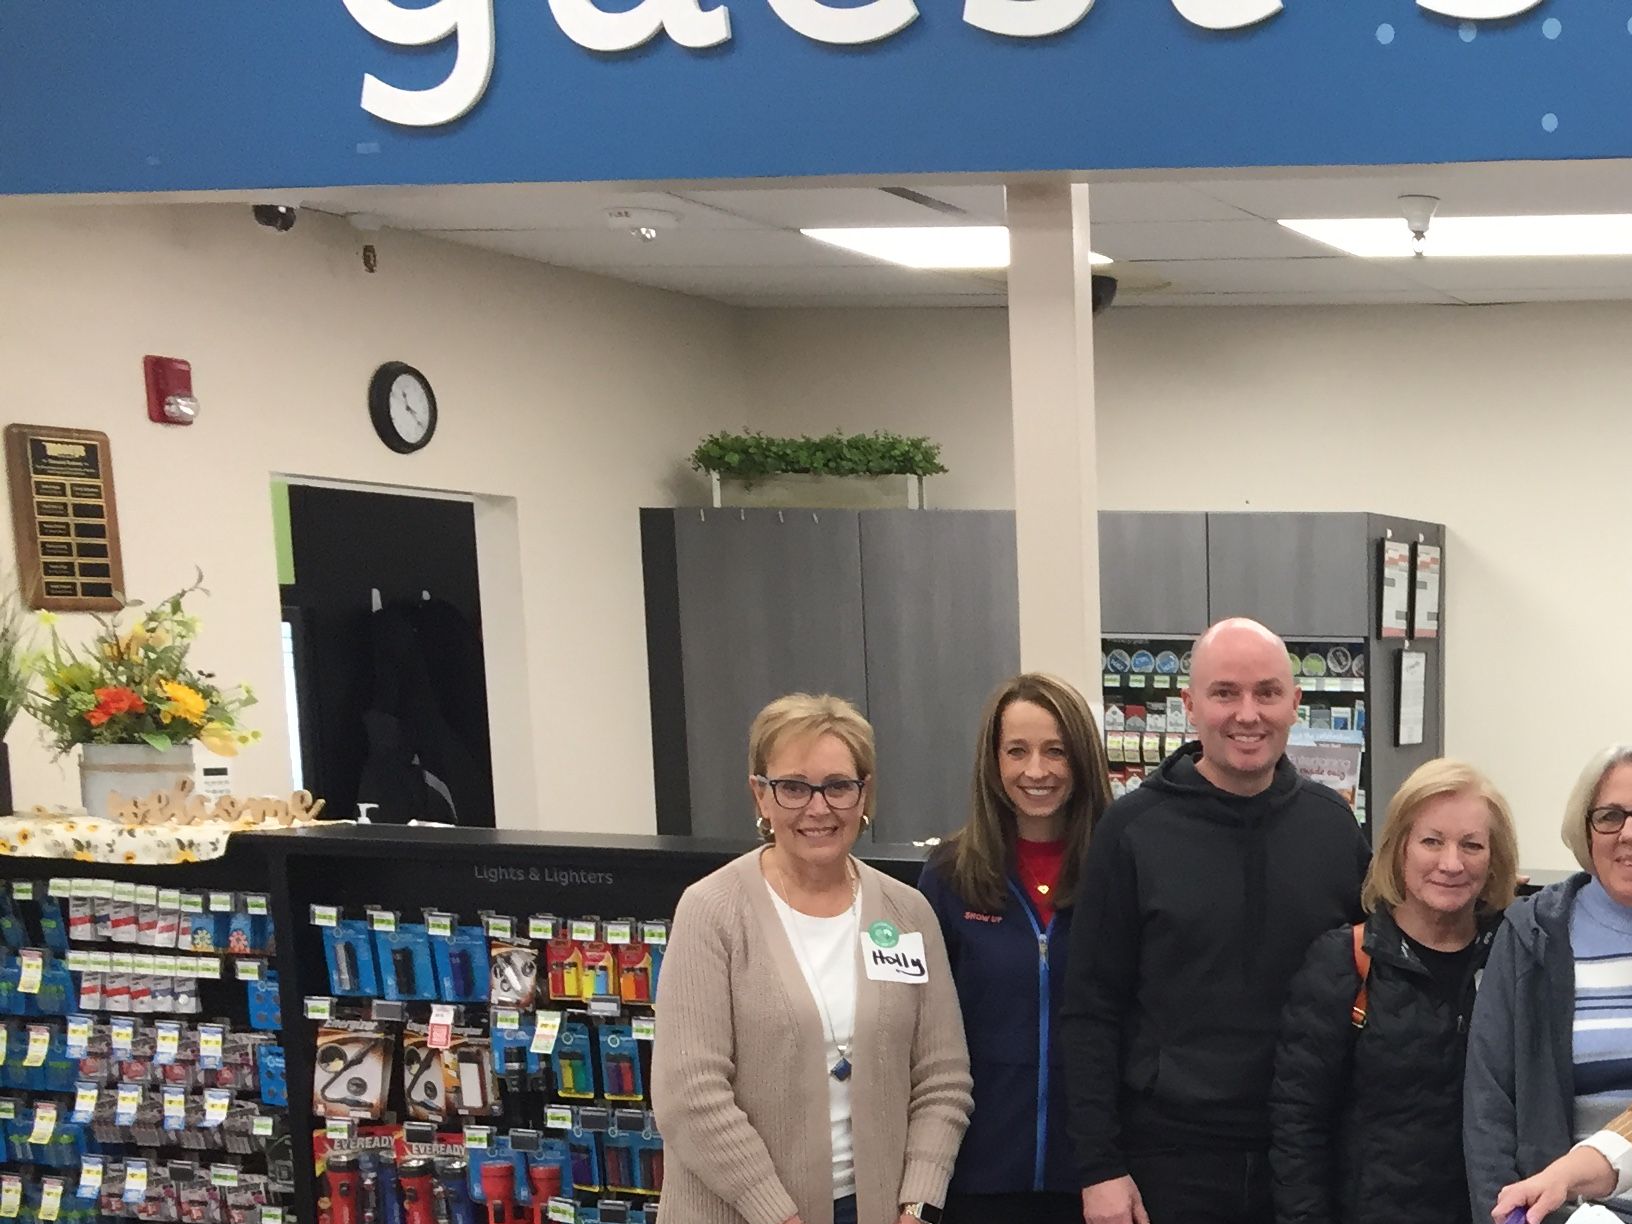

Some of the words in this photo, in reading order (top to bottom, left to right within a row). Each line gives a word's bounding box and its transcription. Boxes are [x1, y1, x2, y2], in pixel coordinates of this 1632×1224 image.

[474, 864, 526, 882] Lights
[529, 866, 541, 881] &
[545, 868, 614, 885] Lighters
[872, 950, 926, 977] Holly
[333, 1134, 397, 1151] EVEREADY
[411, 1142, 466, 1156] EVEREADY
